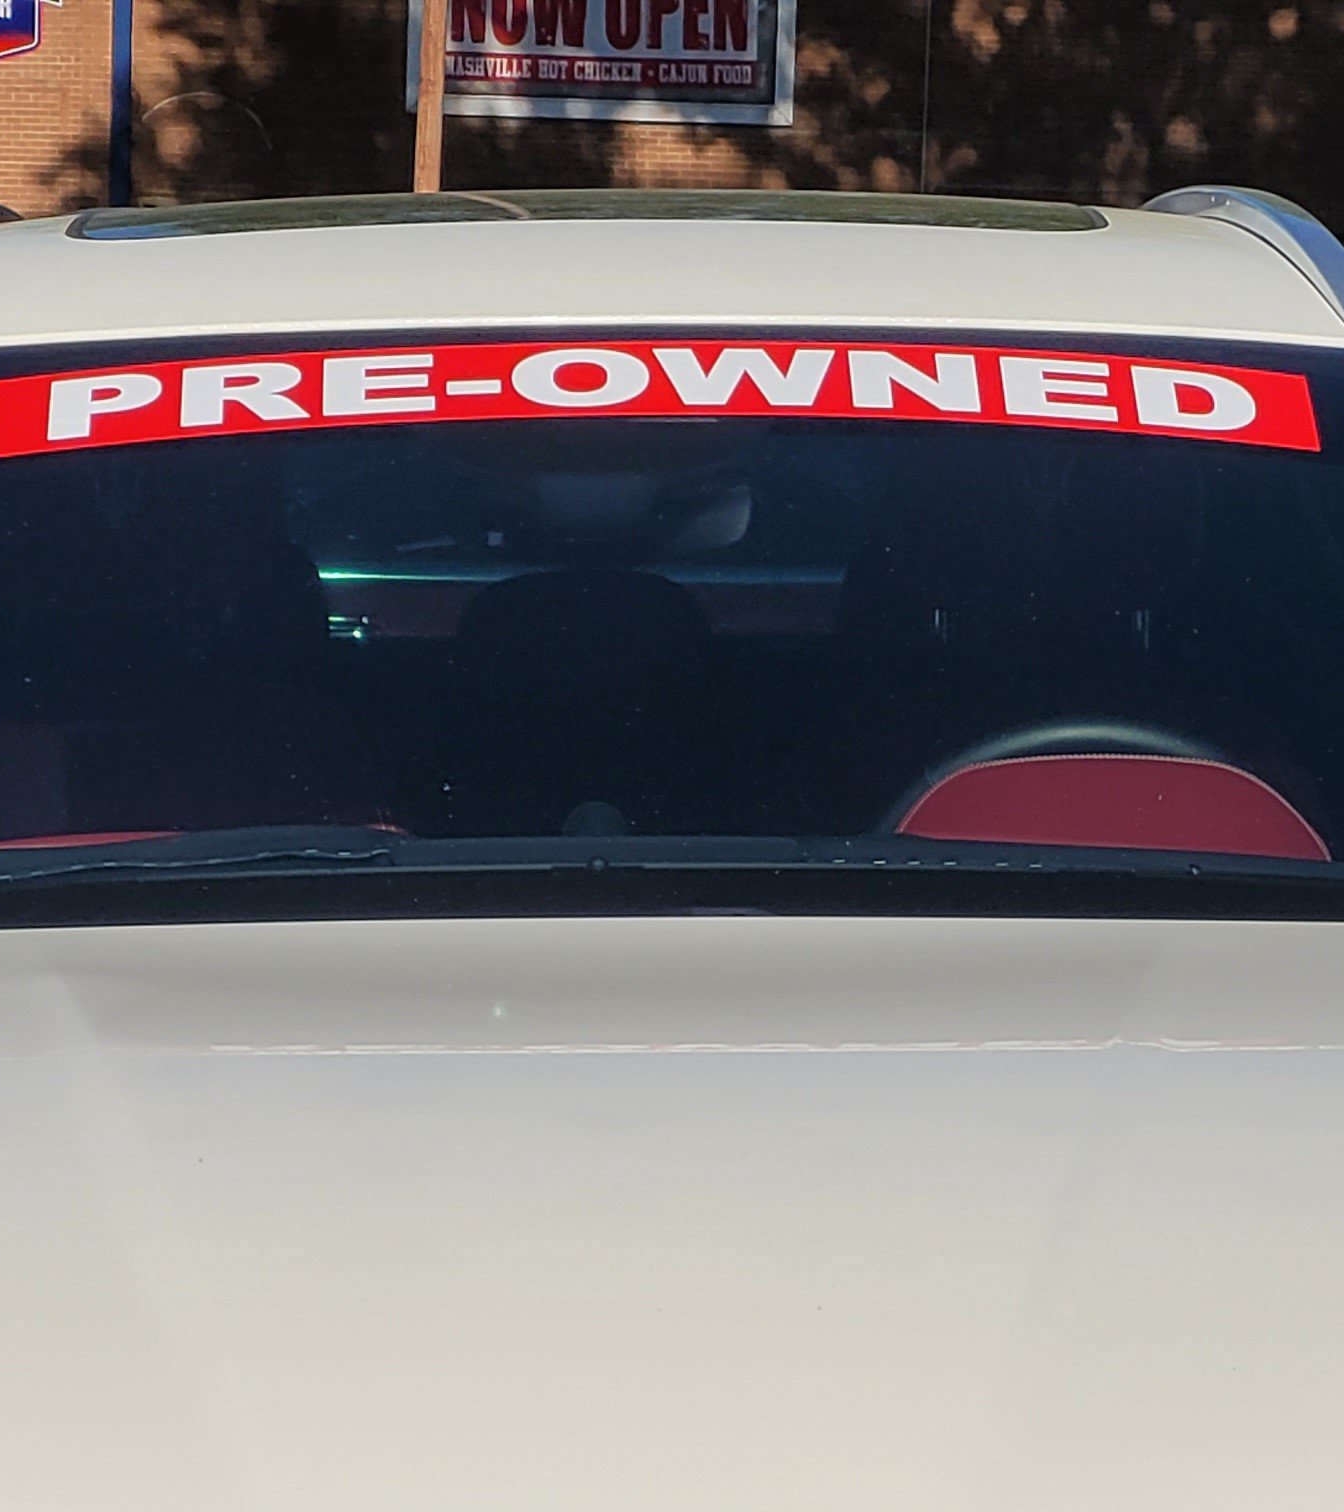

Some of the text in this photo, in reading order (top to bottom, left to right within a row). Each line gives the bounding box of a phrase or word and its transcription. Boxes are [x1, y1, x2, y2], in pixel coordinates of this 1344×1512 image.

[451, 0, 749, 52] NOW OPEN
[446, 55, 753, 85] NASHVILLE HOT CHICKEN CAJUN FOOD
[47, 348, 1256, 441] PRE-OWNED
